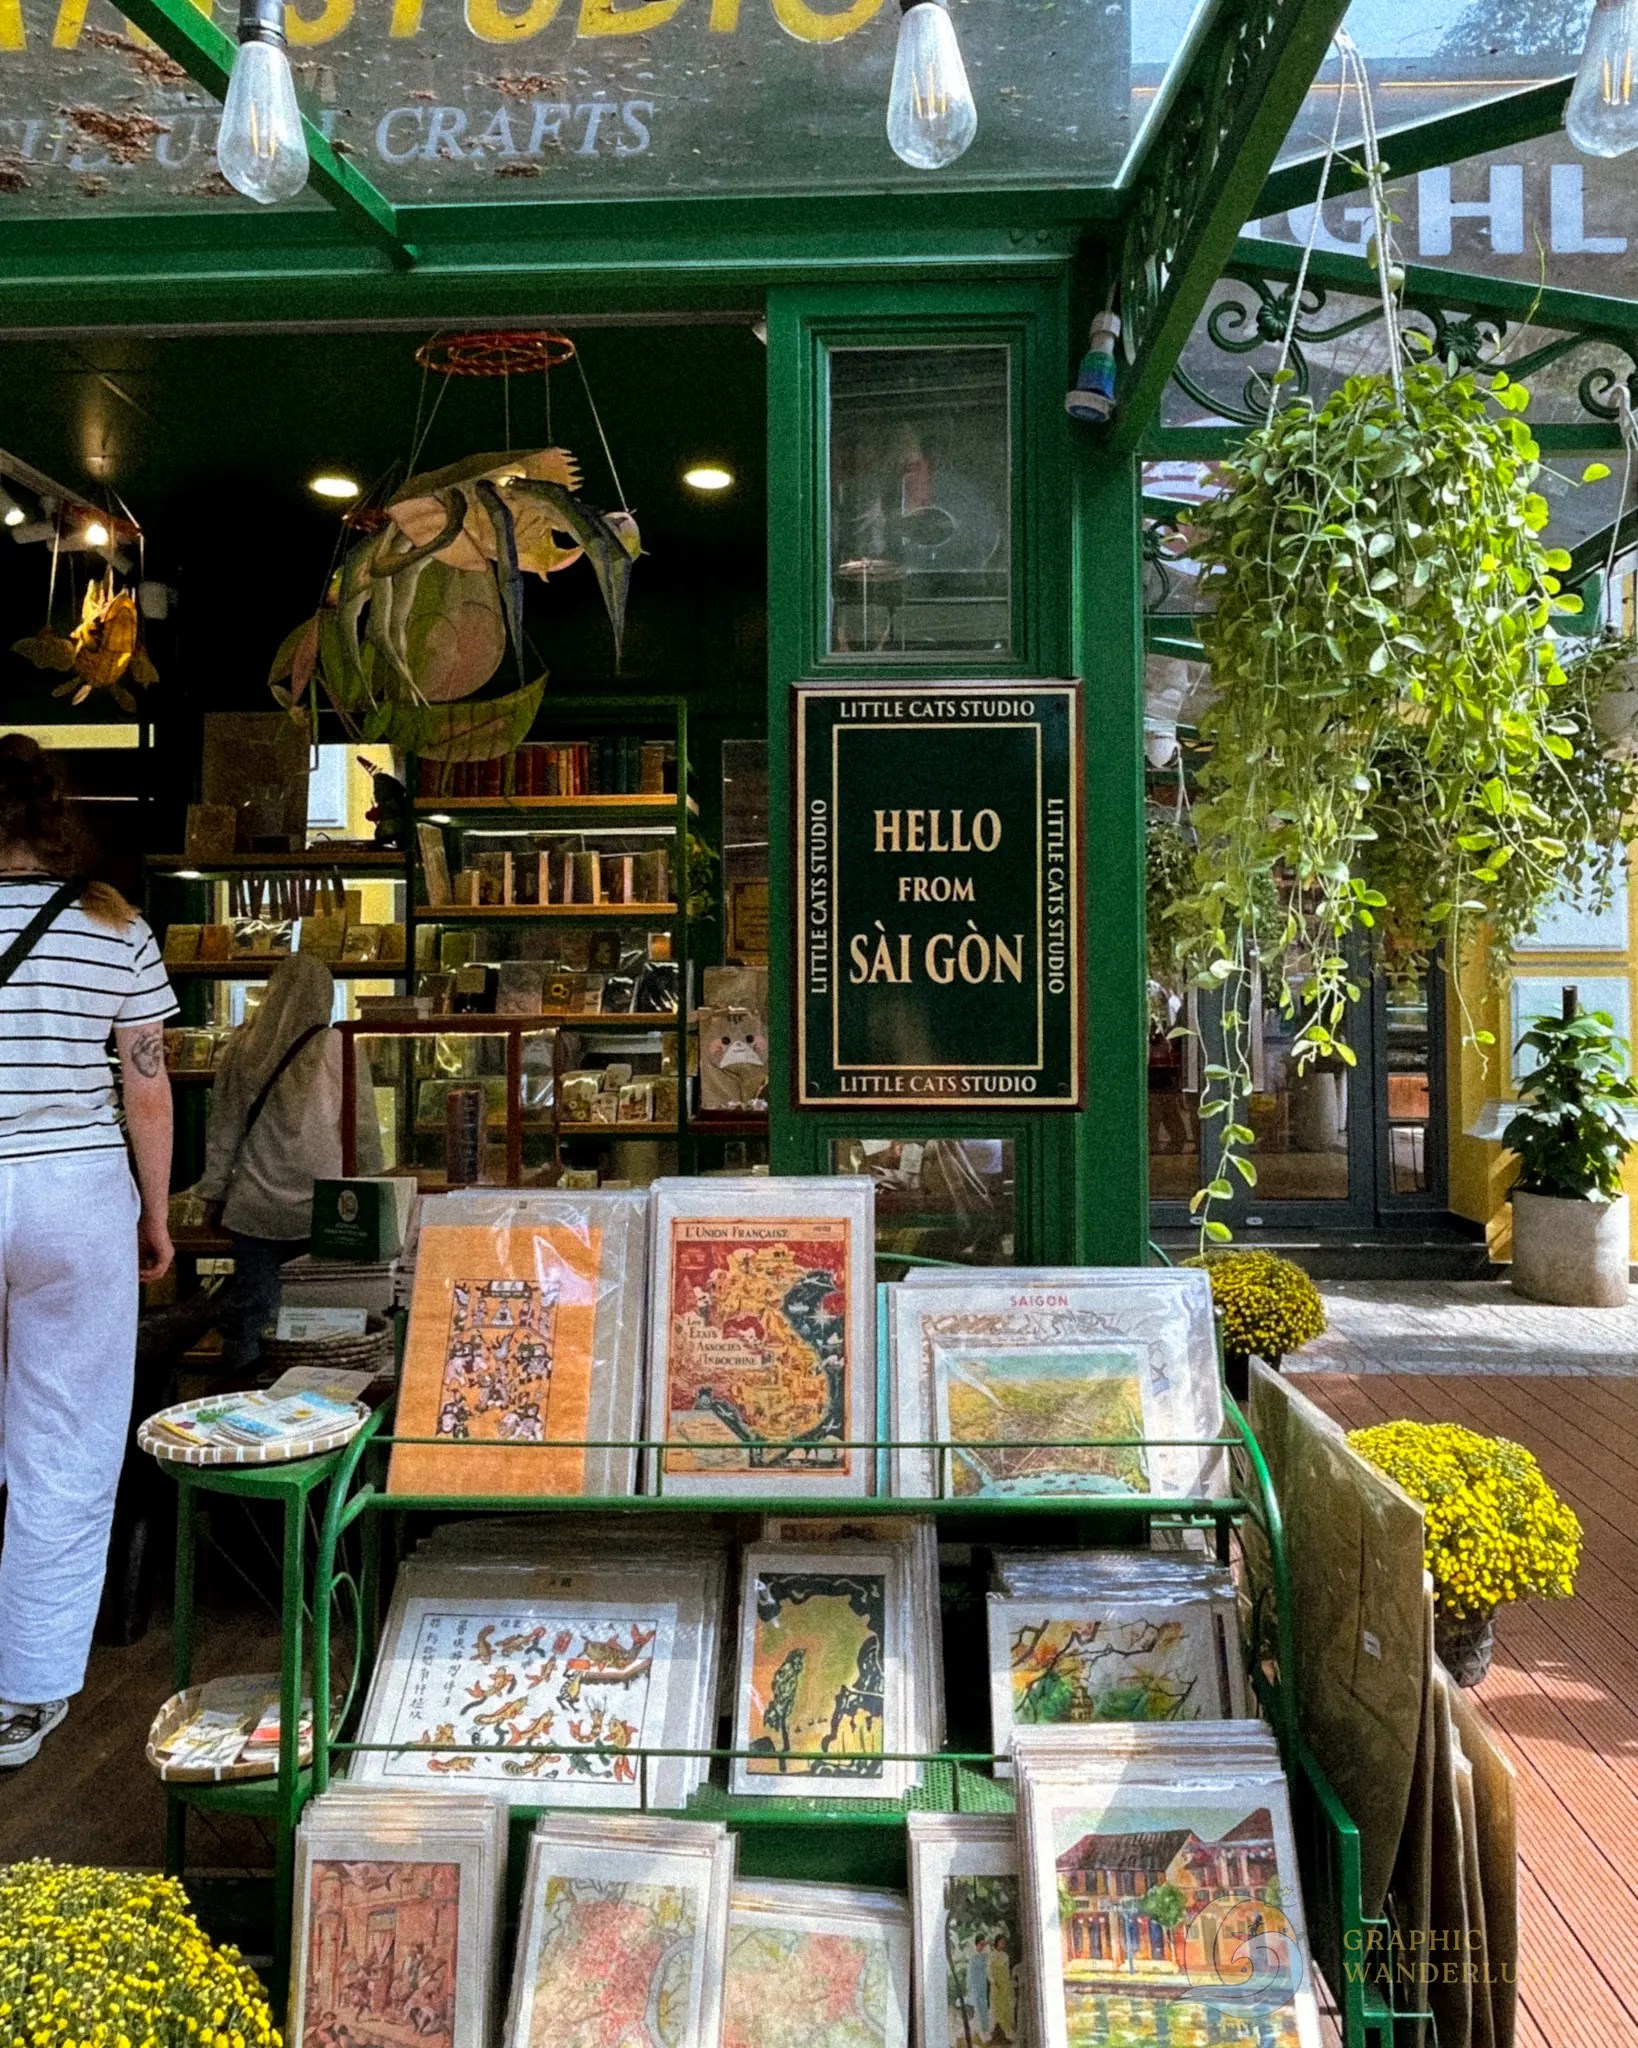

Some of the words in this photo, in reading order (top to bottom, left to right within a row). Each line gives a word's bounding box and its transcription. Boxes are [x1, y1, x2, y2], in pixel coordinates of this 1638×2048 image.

[375, 101, 655, 164] CRAFTS
[840, 701, 904, 718] LITTLE
[909, 700, 956, 717] CATS
[960, 700, 1035, 717] STUDIO
[810, 799, 828, 874] STUDIO
[873, 808, 1002, 853] HELLO
[1047, 798, 1065, 863] LITTLE
[811, 877, 828, 926] CATS
[898, 876, 975, 902] FROM
[1047, 866, 1065, 915] CATS
[811, 929, 828, 994] LITTLE
[849, 920, 912, 985] SÀI
[925, 920, 1025, 985] GÒN
[1047, 917, 1066, 994] STUDIO
[840, 1076, 904, 1093] LITTLE
[909, 1076, 957, 1092] CATS
[960, 1075, 1036, 1092] STUDIO
[1010, 1295, 1068, 1307] SAIGON
